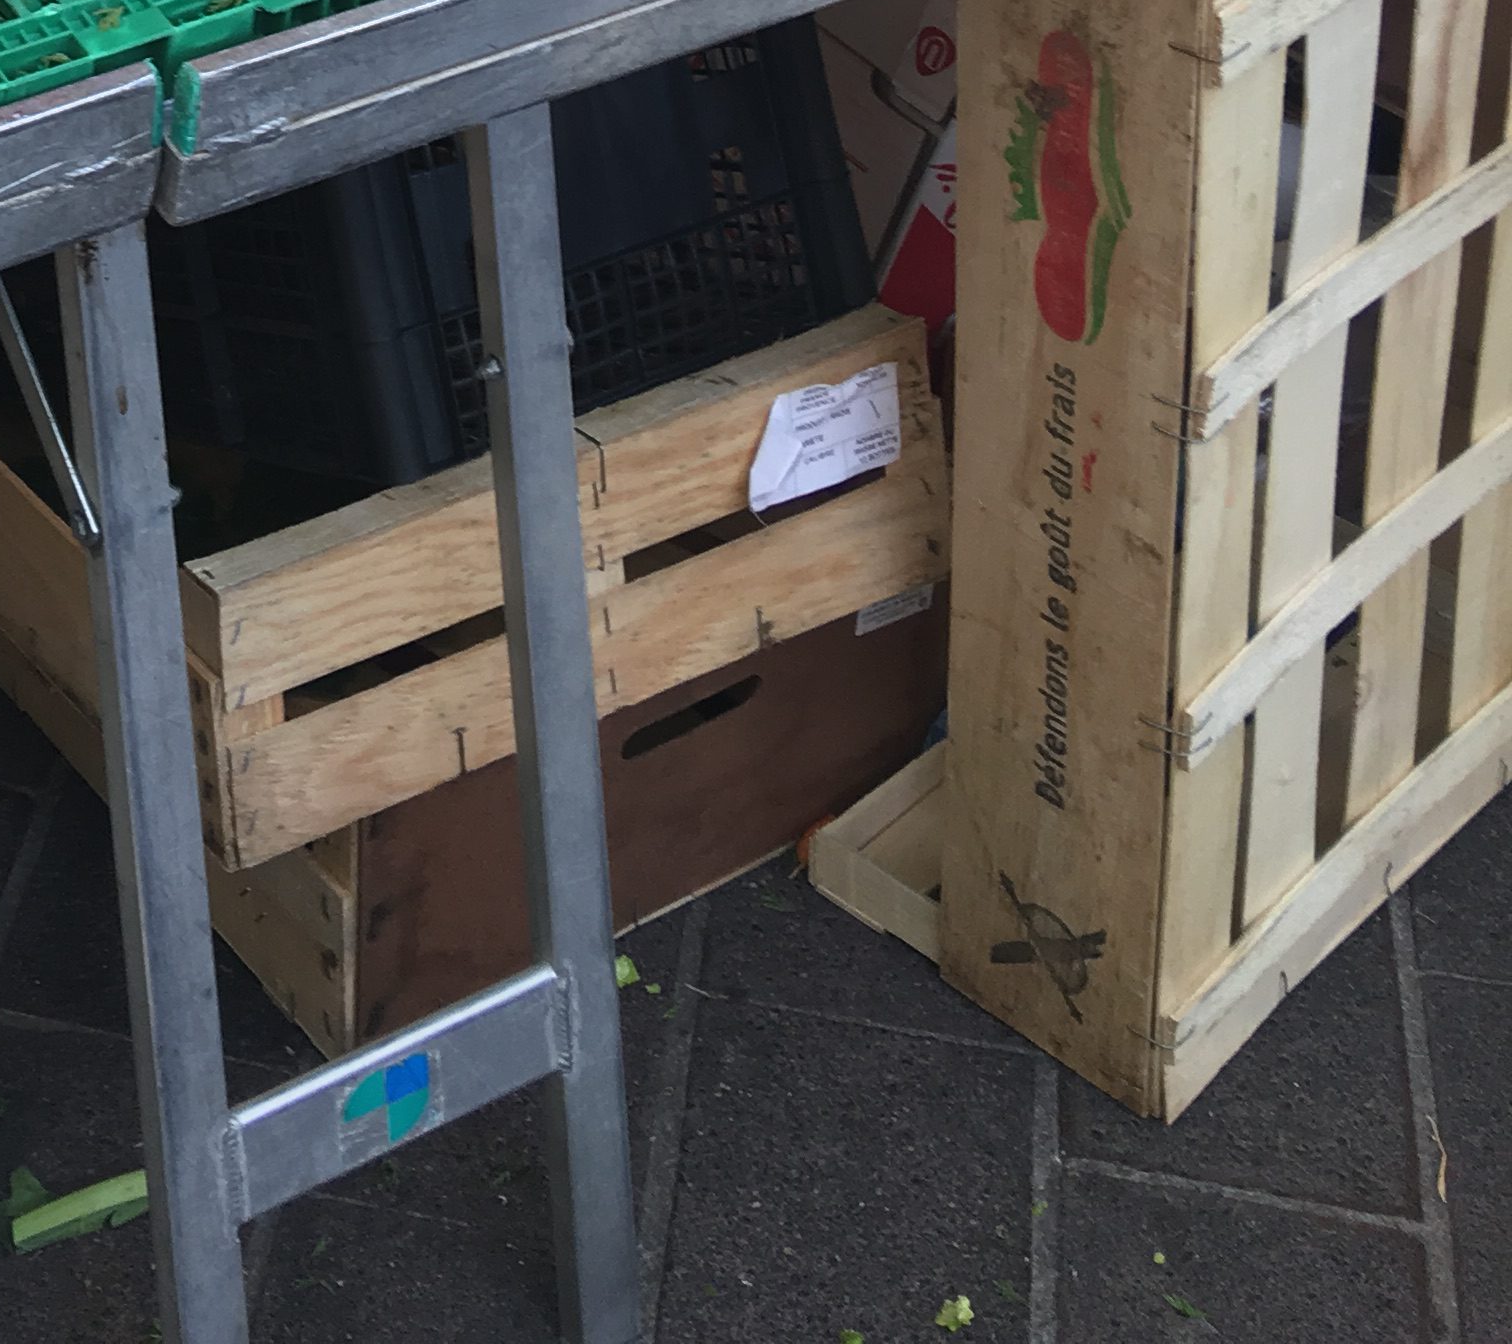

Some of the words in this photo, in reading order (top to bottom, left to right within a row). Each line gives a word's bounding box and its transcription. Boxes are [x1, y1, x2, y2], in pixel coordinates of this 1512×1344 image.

[1044, 361, 1078, 447] frais
[1042, 452, 1073, 502] du
[1039, 508, 1078, 595] goût
[1039, 594, 1070, 633] le
[1033, 637, 1070, 811] Défendons
